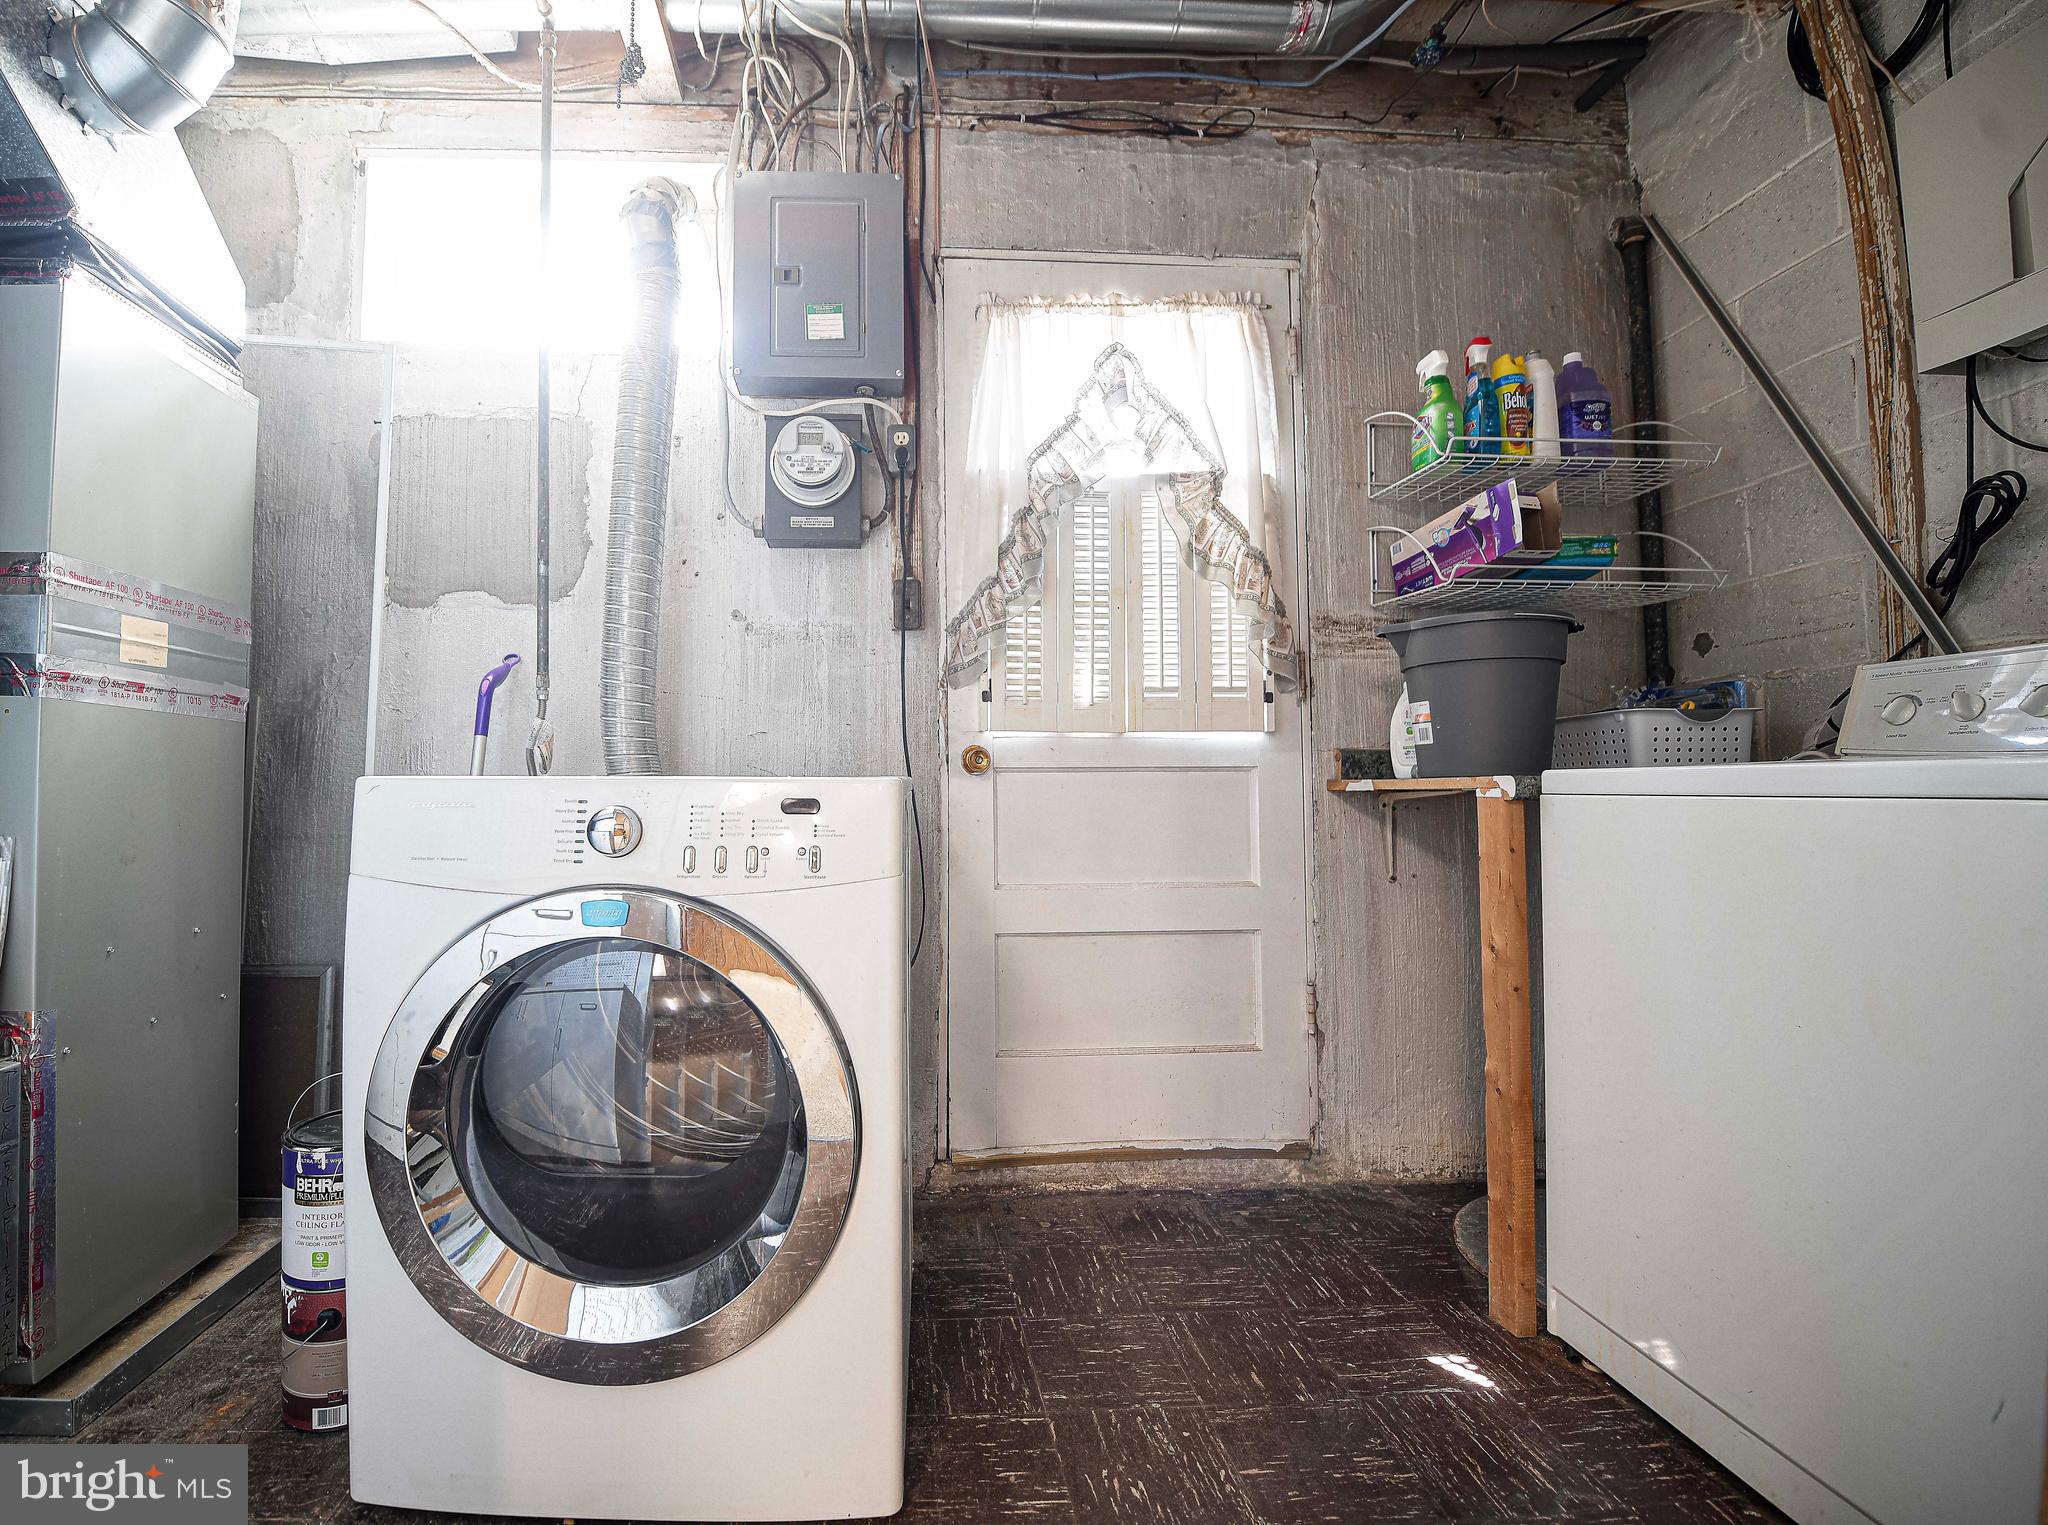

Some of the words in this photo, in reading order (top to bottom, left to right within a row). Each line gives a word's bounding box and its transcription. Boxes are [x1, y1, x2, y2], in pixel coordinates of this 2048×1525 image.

[68, 570, 103, 587] Shurtape
[105, 579, 115, 590] AF
[117, 582, 129, 593] 100
[145, 591, 172, 605] Shurtape
[111, 692, 131, 700] 181A-P
[135, 693, 158, 703] 181B-FX
[296, 1176, 332, 1193] BEHR
[296, 1192, 328, 1201] PREMIUM
[302, 1212, 344, 1221] INTERIOR
[295, 1220, 328, 1229] CEILING
